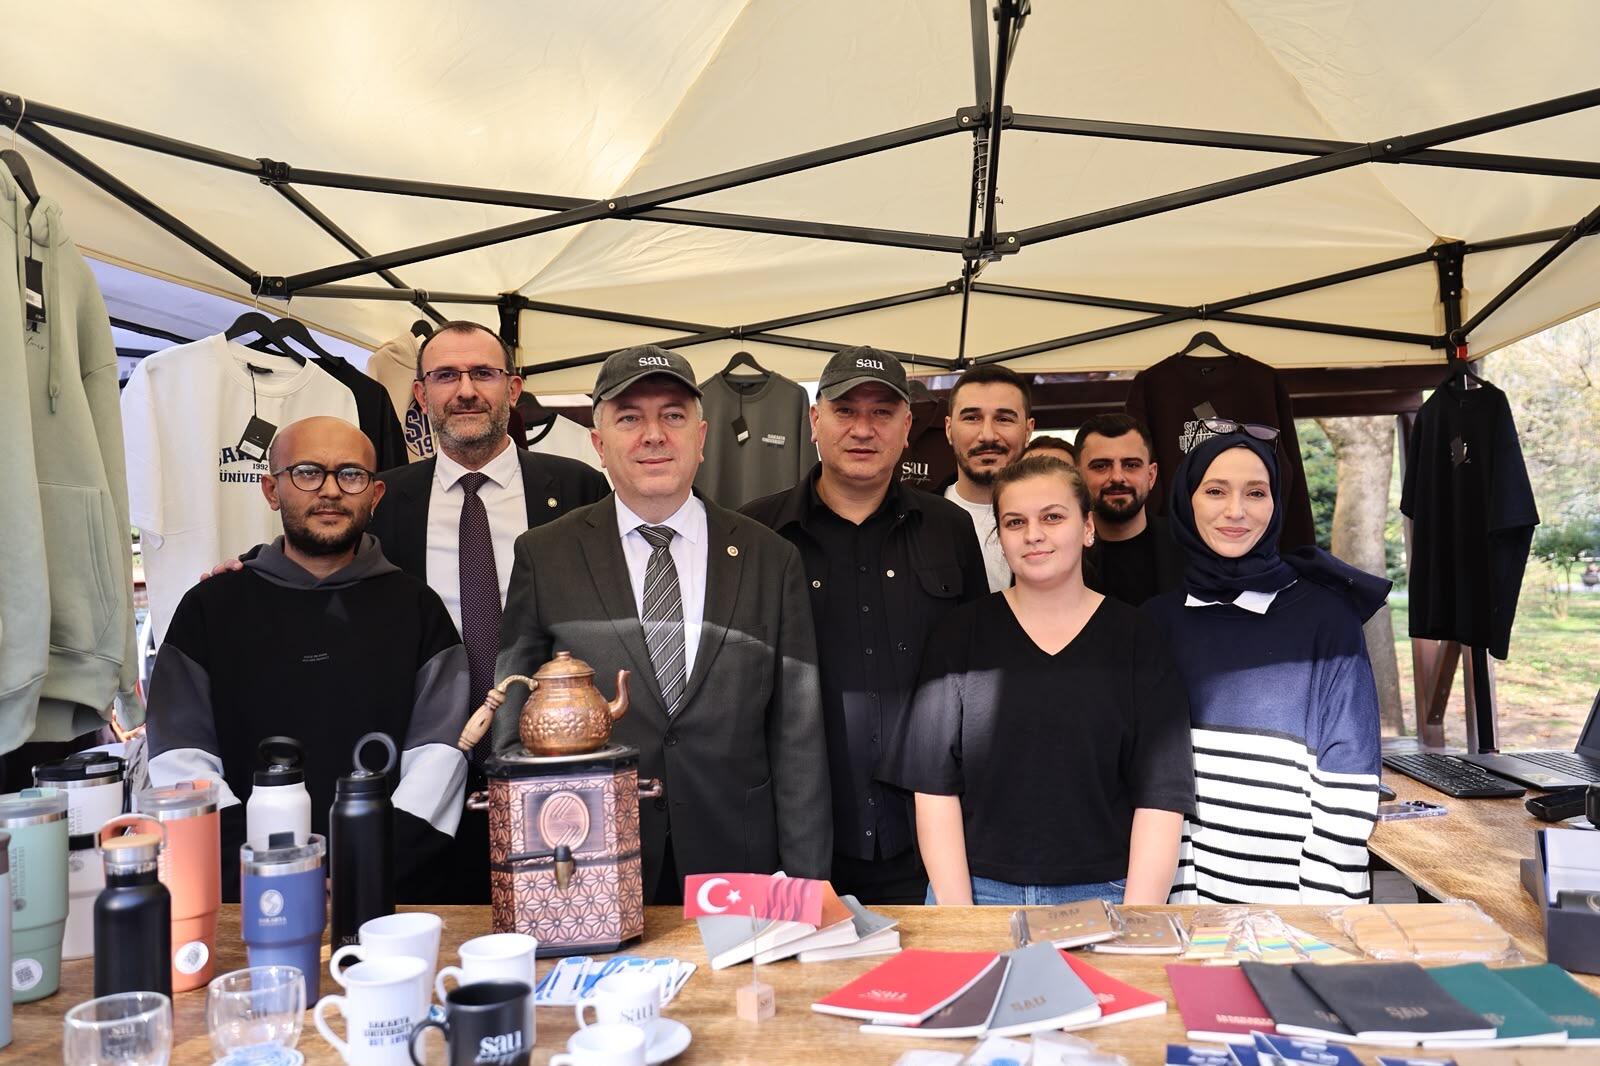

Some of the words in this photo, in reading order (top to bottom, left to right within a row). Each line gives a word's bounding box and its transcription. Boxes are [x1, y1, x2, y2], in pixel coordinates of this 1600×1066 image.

[638, 355, 671, 367] sau
[856, 358, 885, 371] sau
[252, 463, 269, 471] 1992
[902, 461, 929, 475] sau
[480, 1030, 522, 1056] sau
